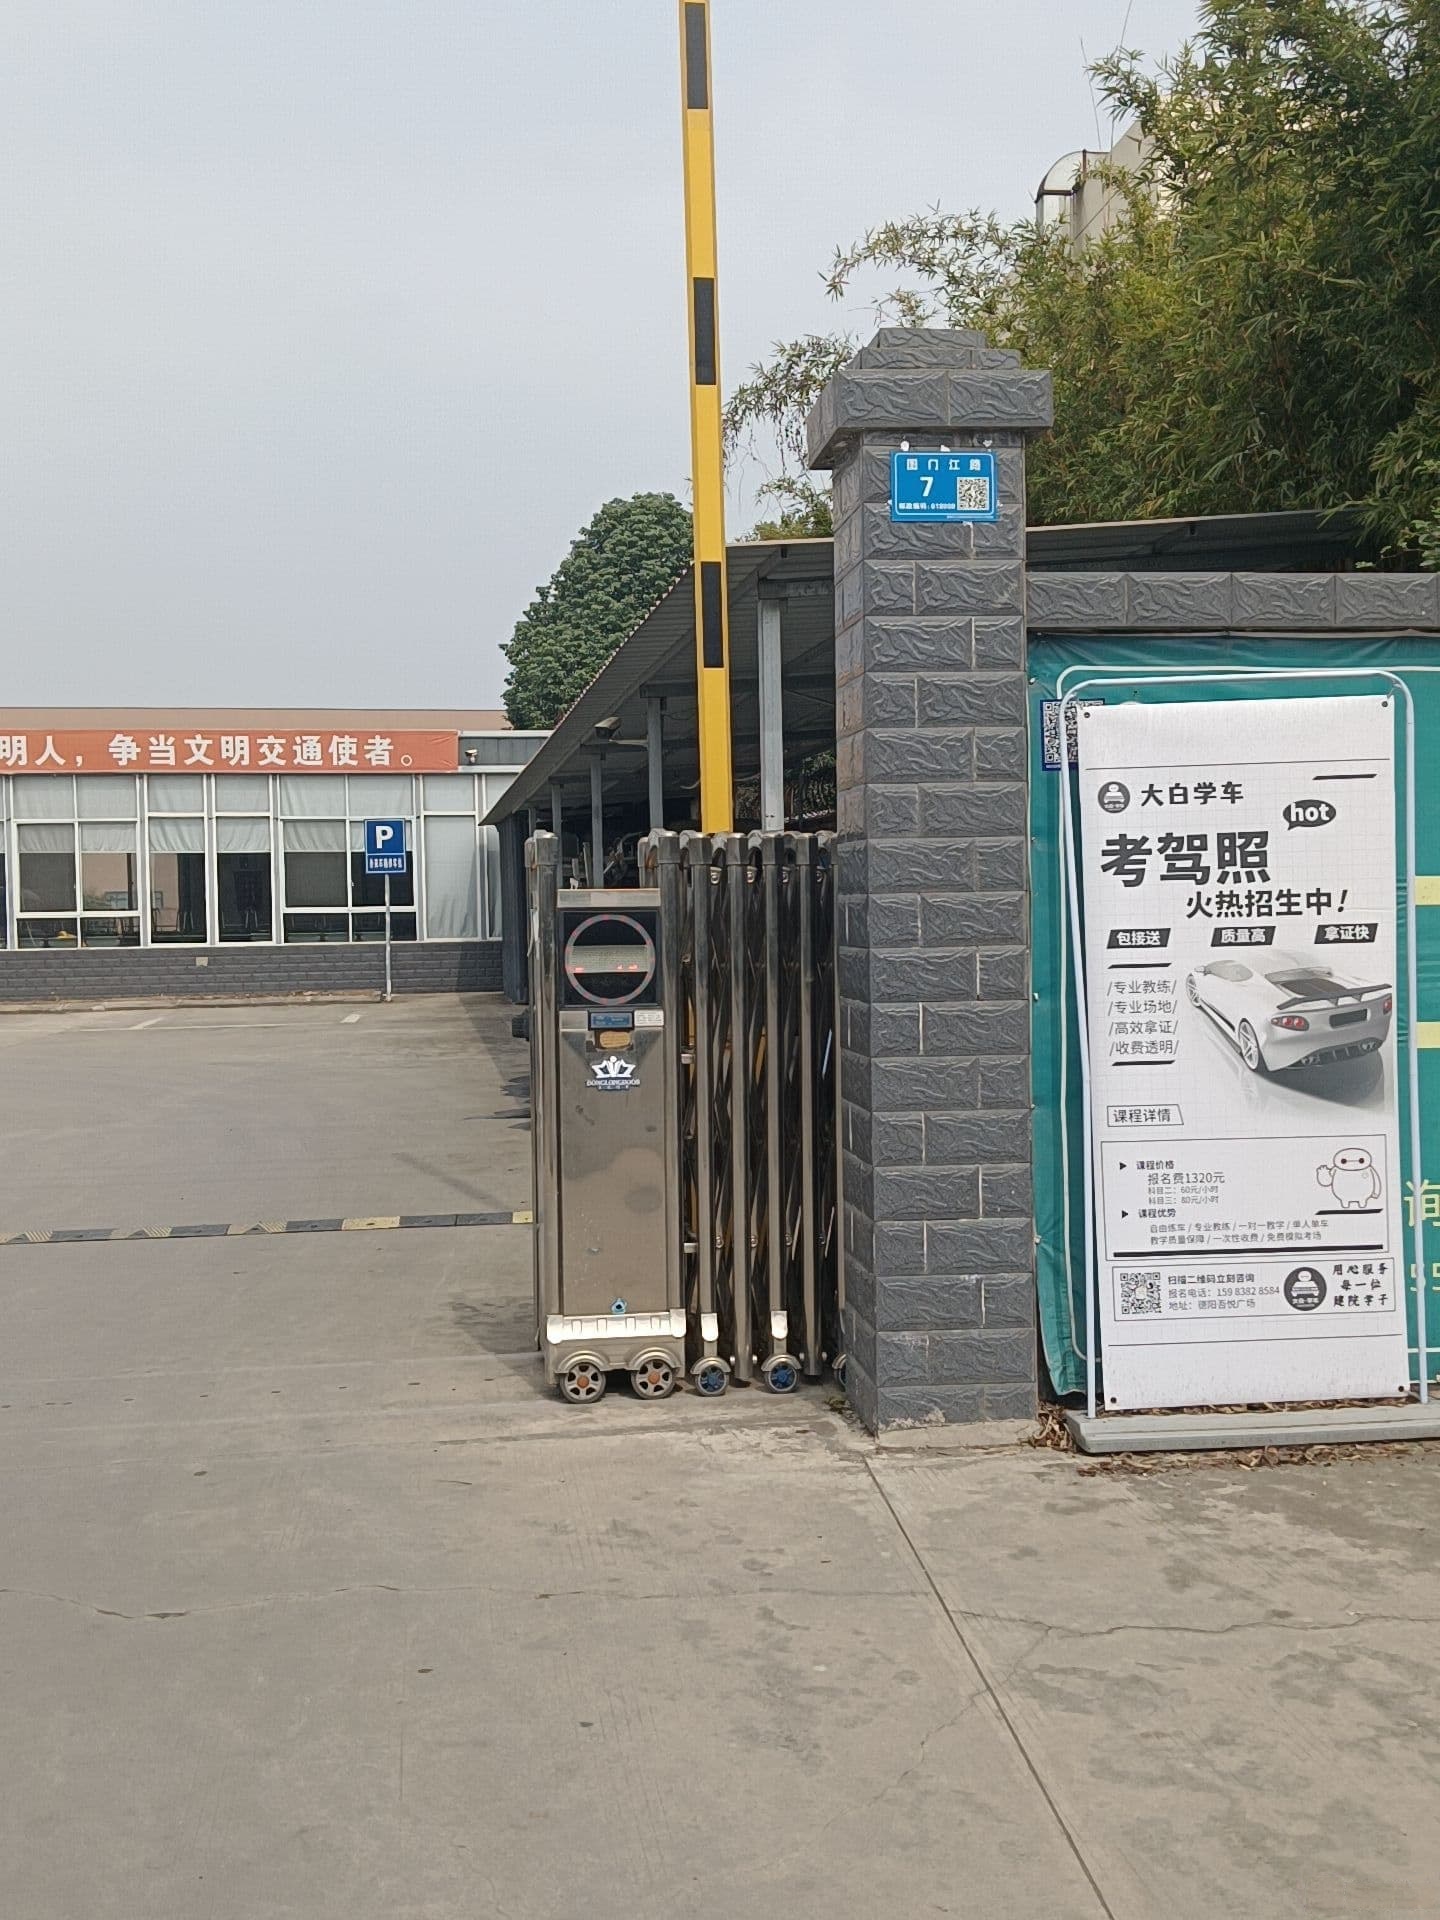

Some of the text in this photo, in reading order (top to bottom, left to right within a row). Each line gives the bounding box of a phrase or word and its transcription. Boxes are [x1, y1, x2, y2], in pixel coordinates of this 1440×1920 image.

[920, 476, 934, 497] 7
[1141, 781, 1244, 807] 大白学车
[1290, 802, 1330, 822] hot
[376, 825, 394, 849] P
[1100, 830, 1271, 888] 考驾照
[1116, 930, 1162, 946] 包接送
[1220, 927, 1267, 944] 质量高
[1323, 925, 1370, 941] 拿证快
[1112, 1108, 1171, 1124] 课程详情
[1147, 1171, 1226, 1186] 报名费1320元
